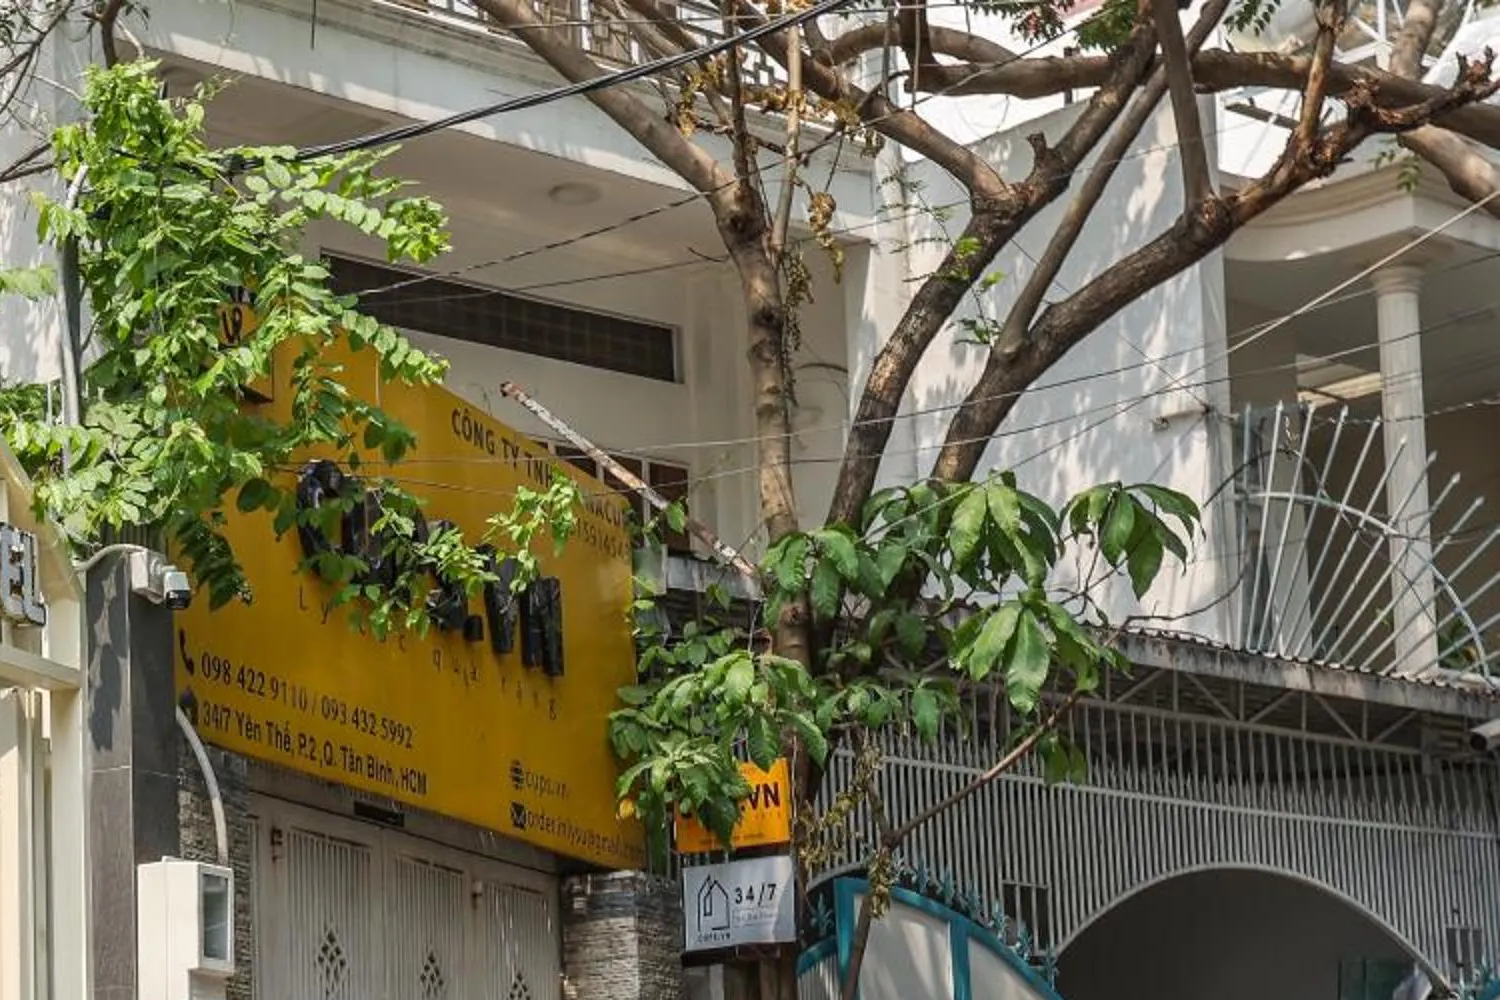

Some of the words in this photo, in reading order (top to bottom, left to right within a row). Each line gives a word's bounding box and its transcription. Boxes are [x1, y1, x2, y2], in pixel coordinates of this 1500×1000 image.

[452, 409, 496, 455] CÔNG
[201, 651, 231, 686] 098
[236, 665, 266, 697] 422
[321, 694, 348, 726] 093
[352, 706, 377, 739] 432
[380, 717, 413, 750] 5992
[734, 882, 777, 907] 34/7
